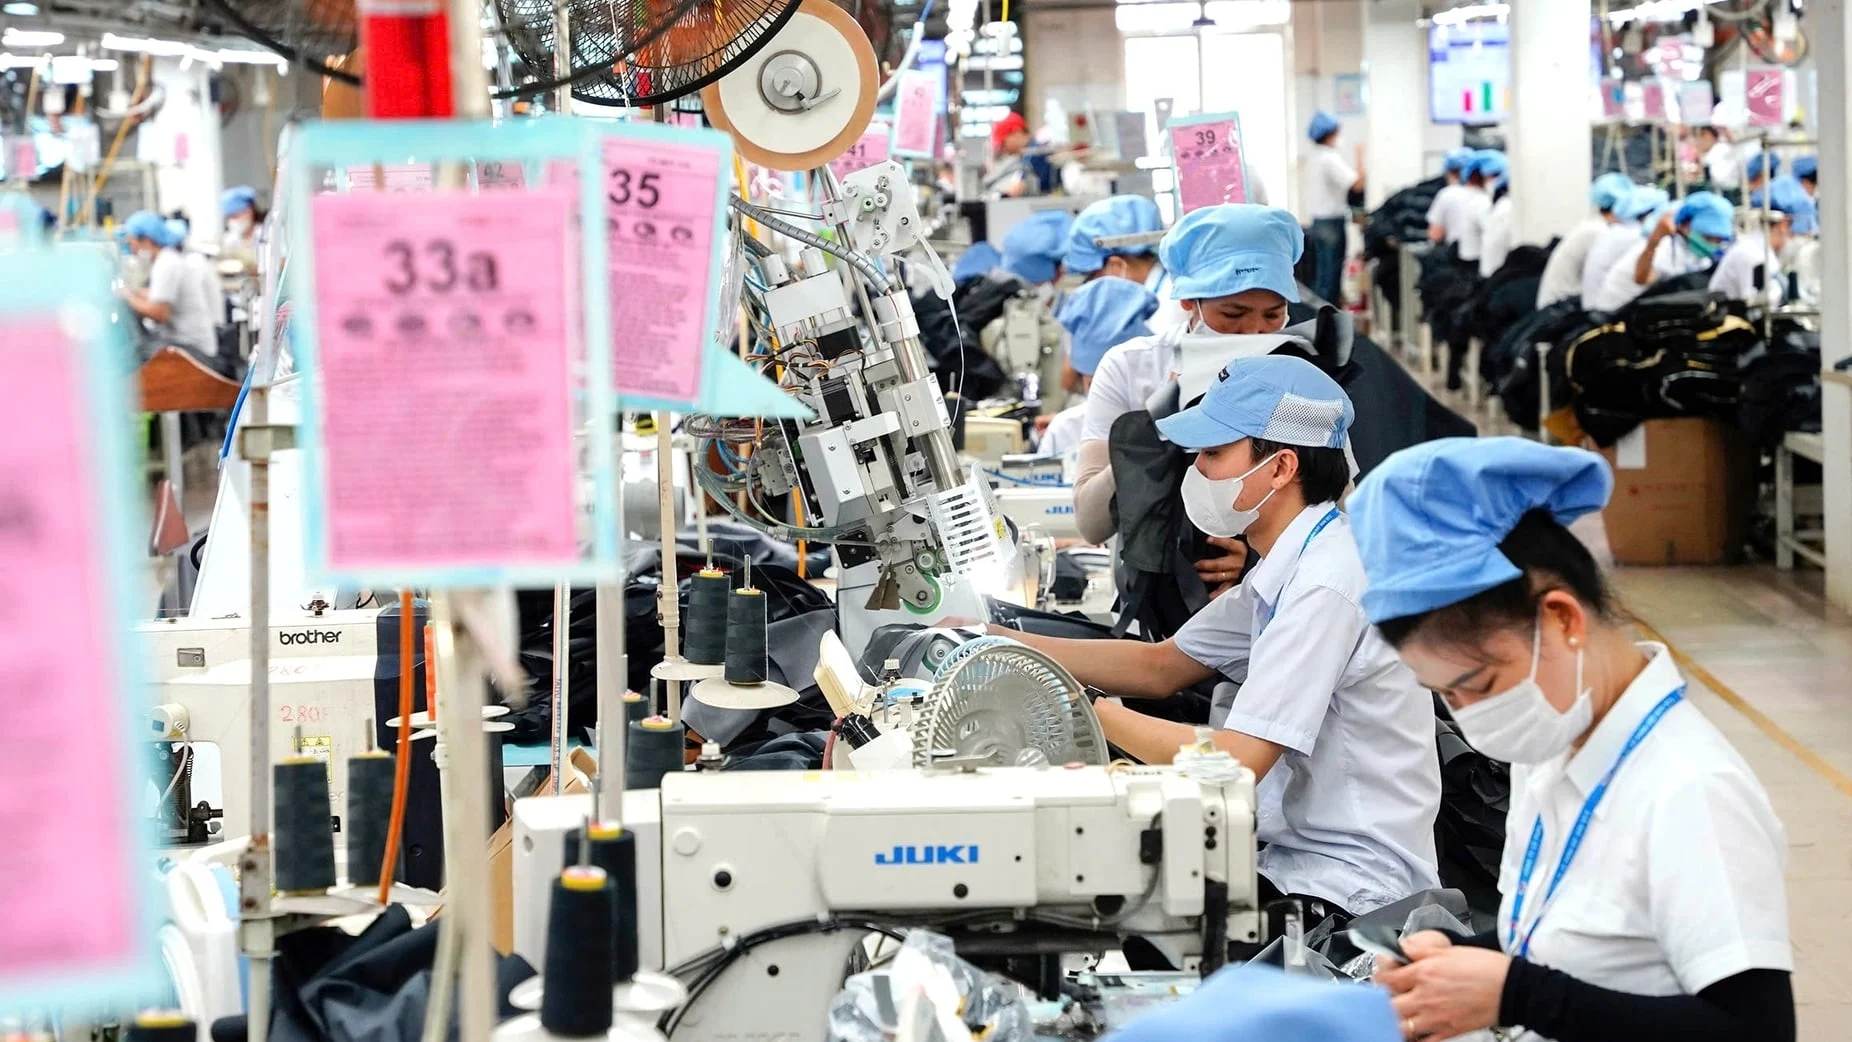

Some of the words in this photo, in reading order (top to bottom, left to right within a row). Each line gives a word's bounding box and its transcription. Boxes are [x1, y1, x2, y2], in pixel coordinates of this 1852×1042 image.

[1194, 129, 1216, 146] 39
[847, 143, 866, 157] 41
[608, 168, 660, 208] 35
[382, 237, 500, 295] 33a
[279, 629, 342, 645] brother
[875, 845, 979, 864] JUKI
